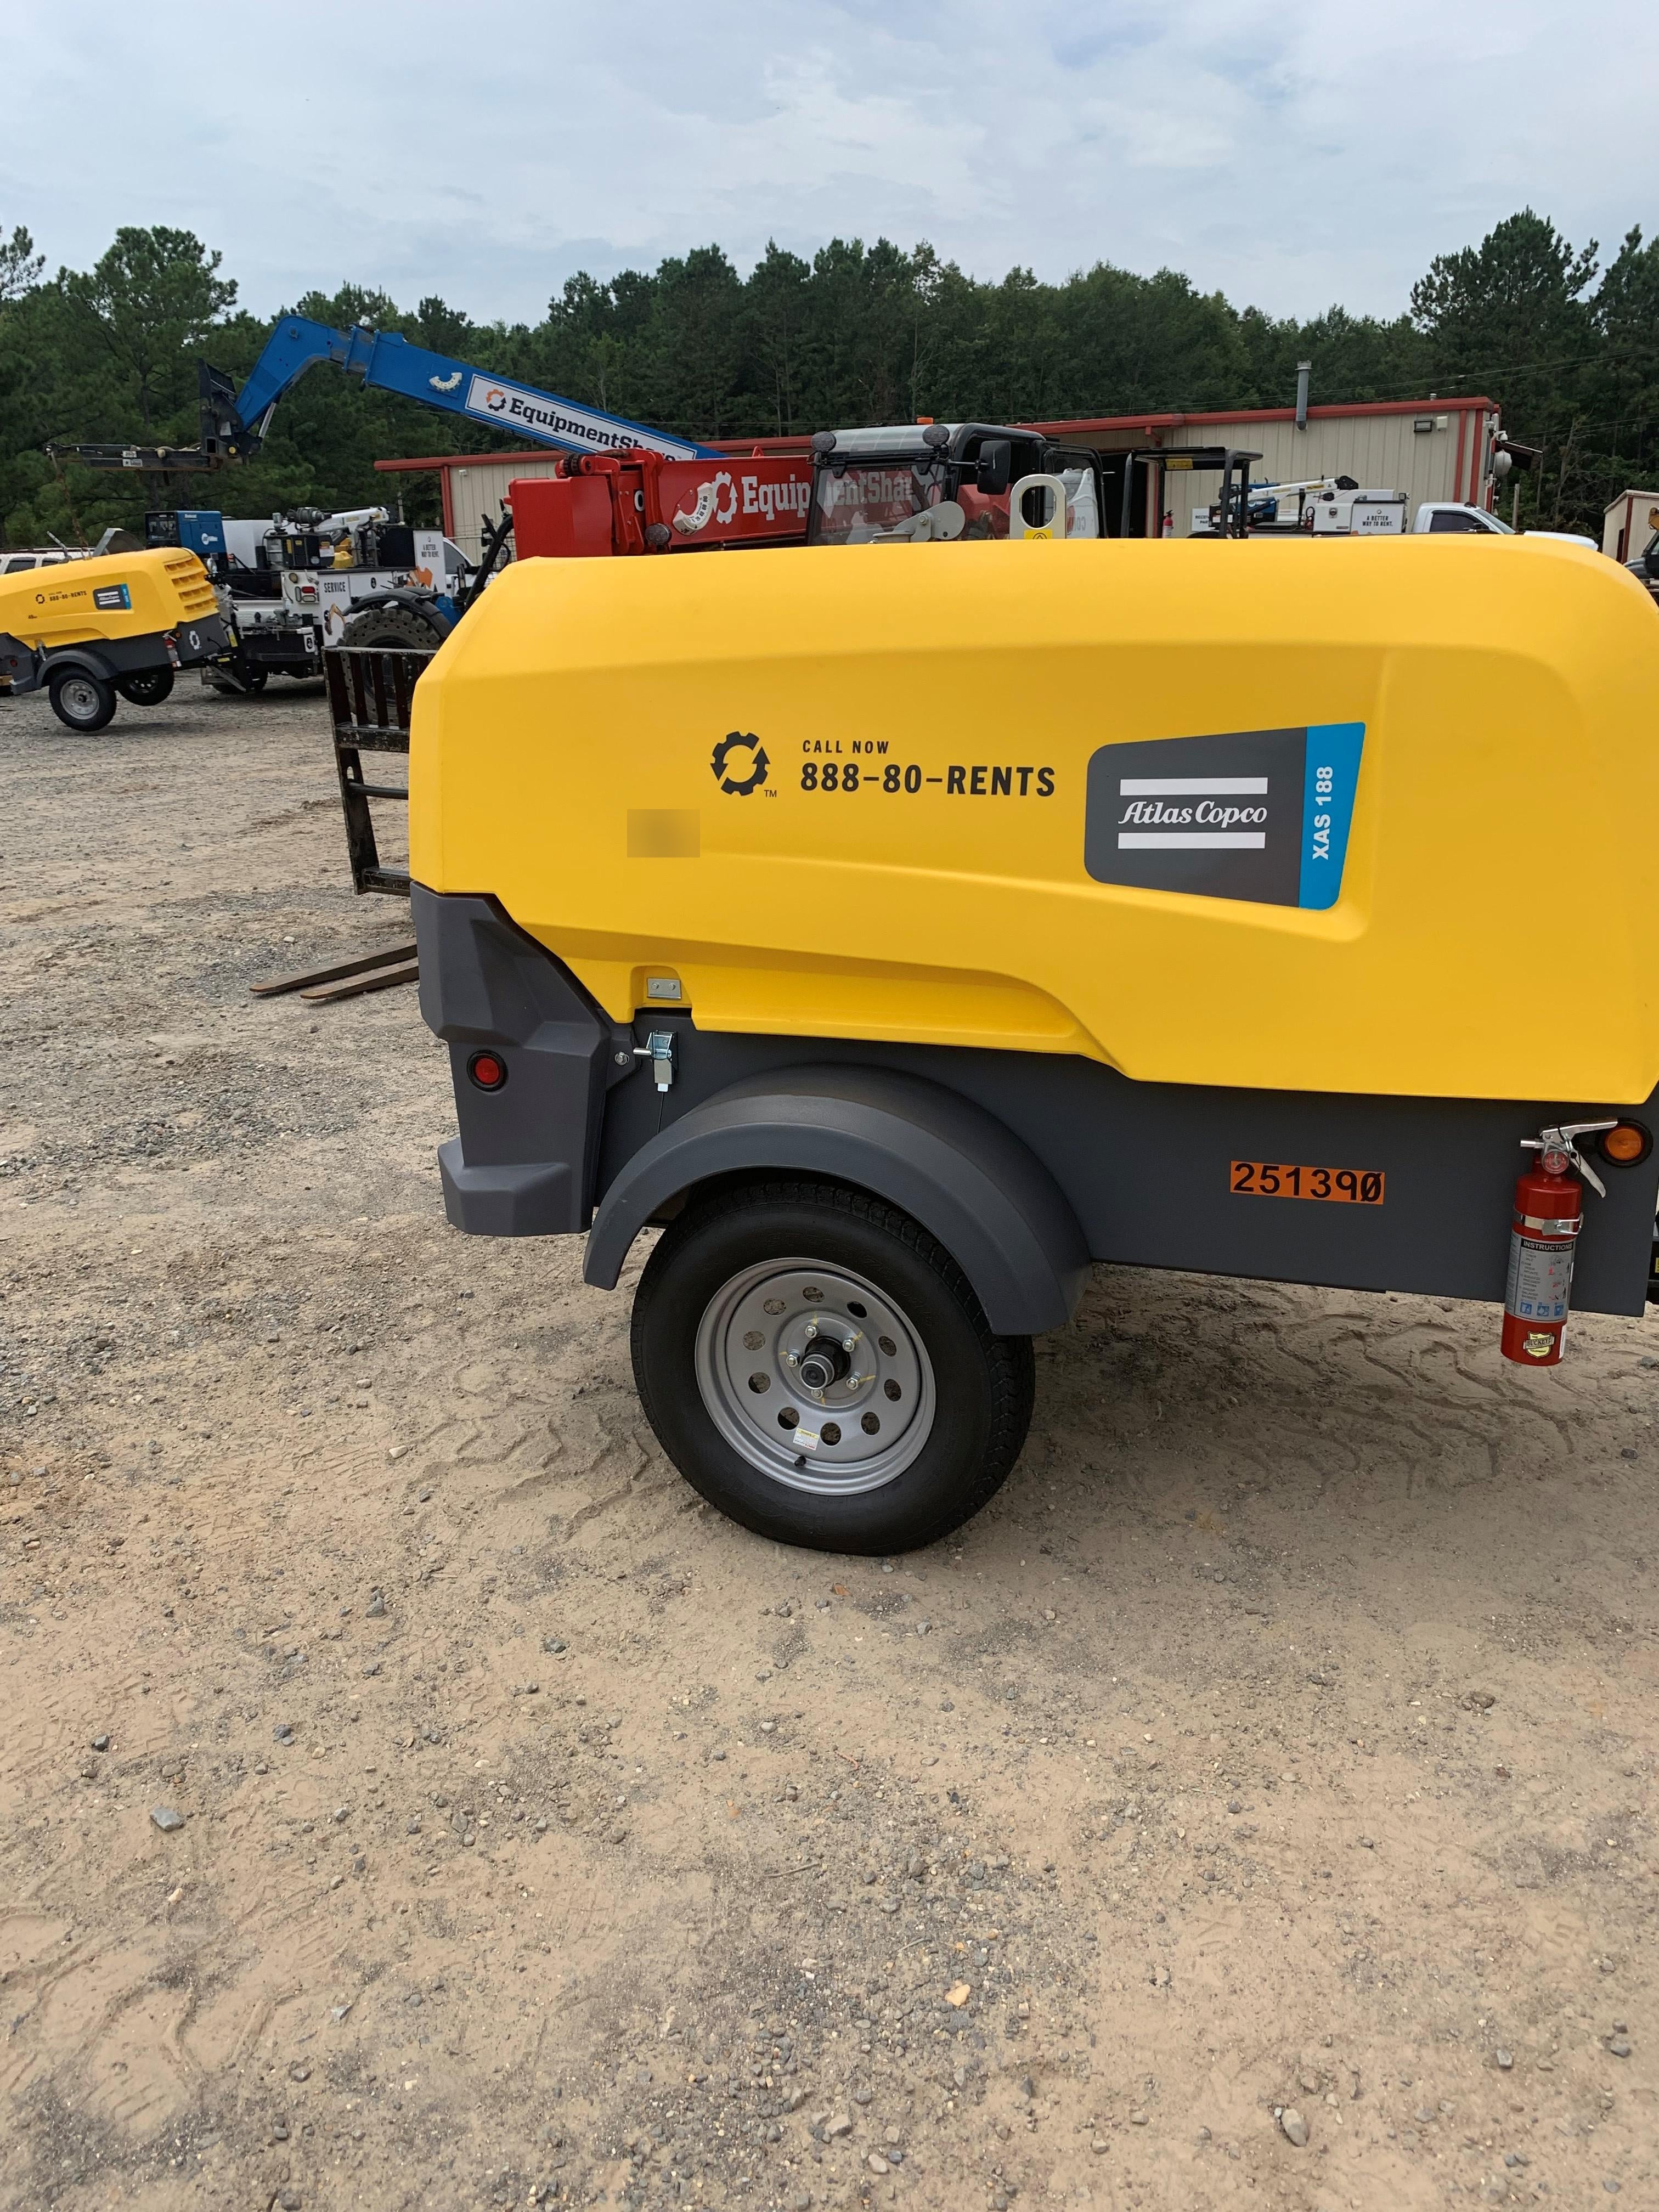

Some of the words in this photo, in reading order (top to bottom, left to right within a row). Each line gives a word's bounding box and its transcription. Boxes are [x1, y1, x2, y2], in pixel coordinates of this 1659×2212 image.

[509, 397, 676, 461] EquipmentSh
[324, 582, 346, 593] SERVICE
[803, 740, 843, 753] CALL
[852, 741, 889, 754] NOW
[764, 789, 777, 798] TM
[800, 763, 1055, 797] 888-80-RENTS
[1316, 766, 1333, 806] 188
[1118, 801, 1193, 825] Atlas
[1195, 800, 1267, 828] Copco
[1312, 814, 1331, 860] XAS
[1233, 1163, 1382, 1202] 251390
[1523, 1240, 1572, 1251] INSTRUCTIONS
[1527, 1337, 1553, 1346] BUCKEYE
